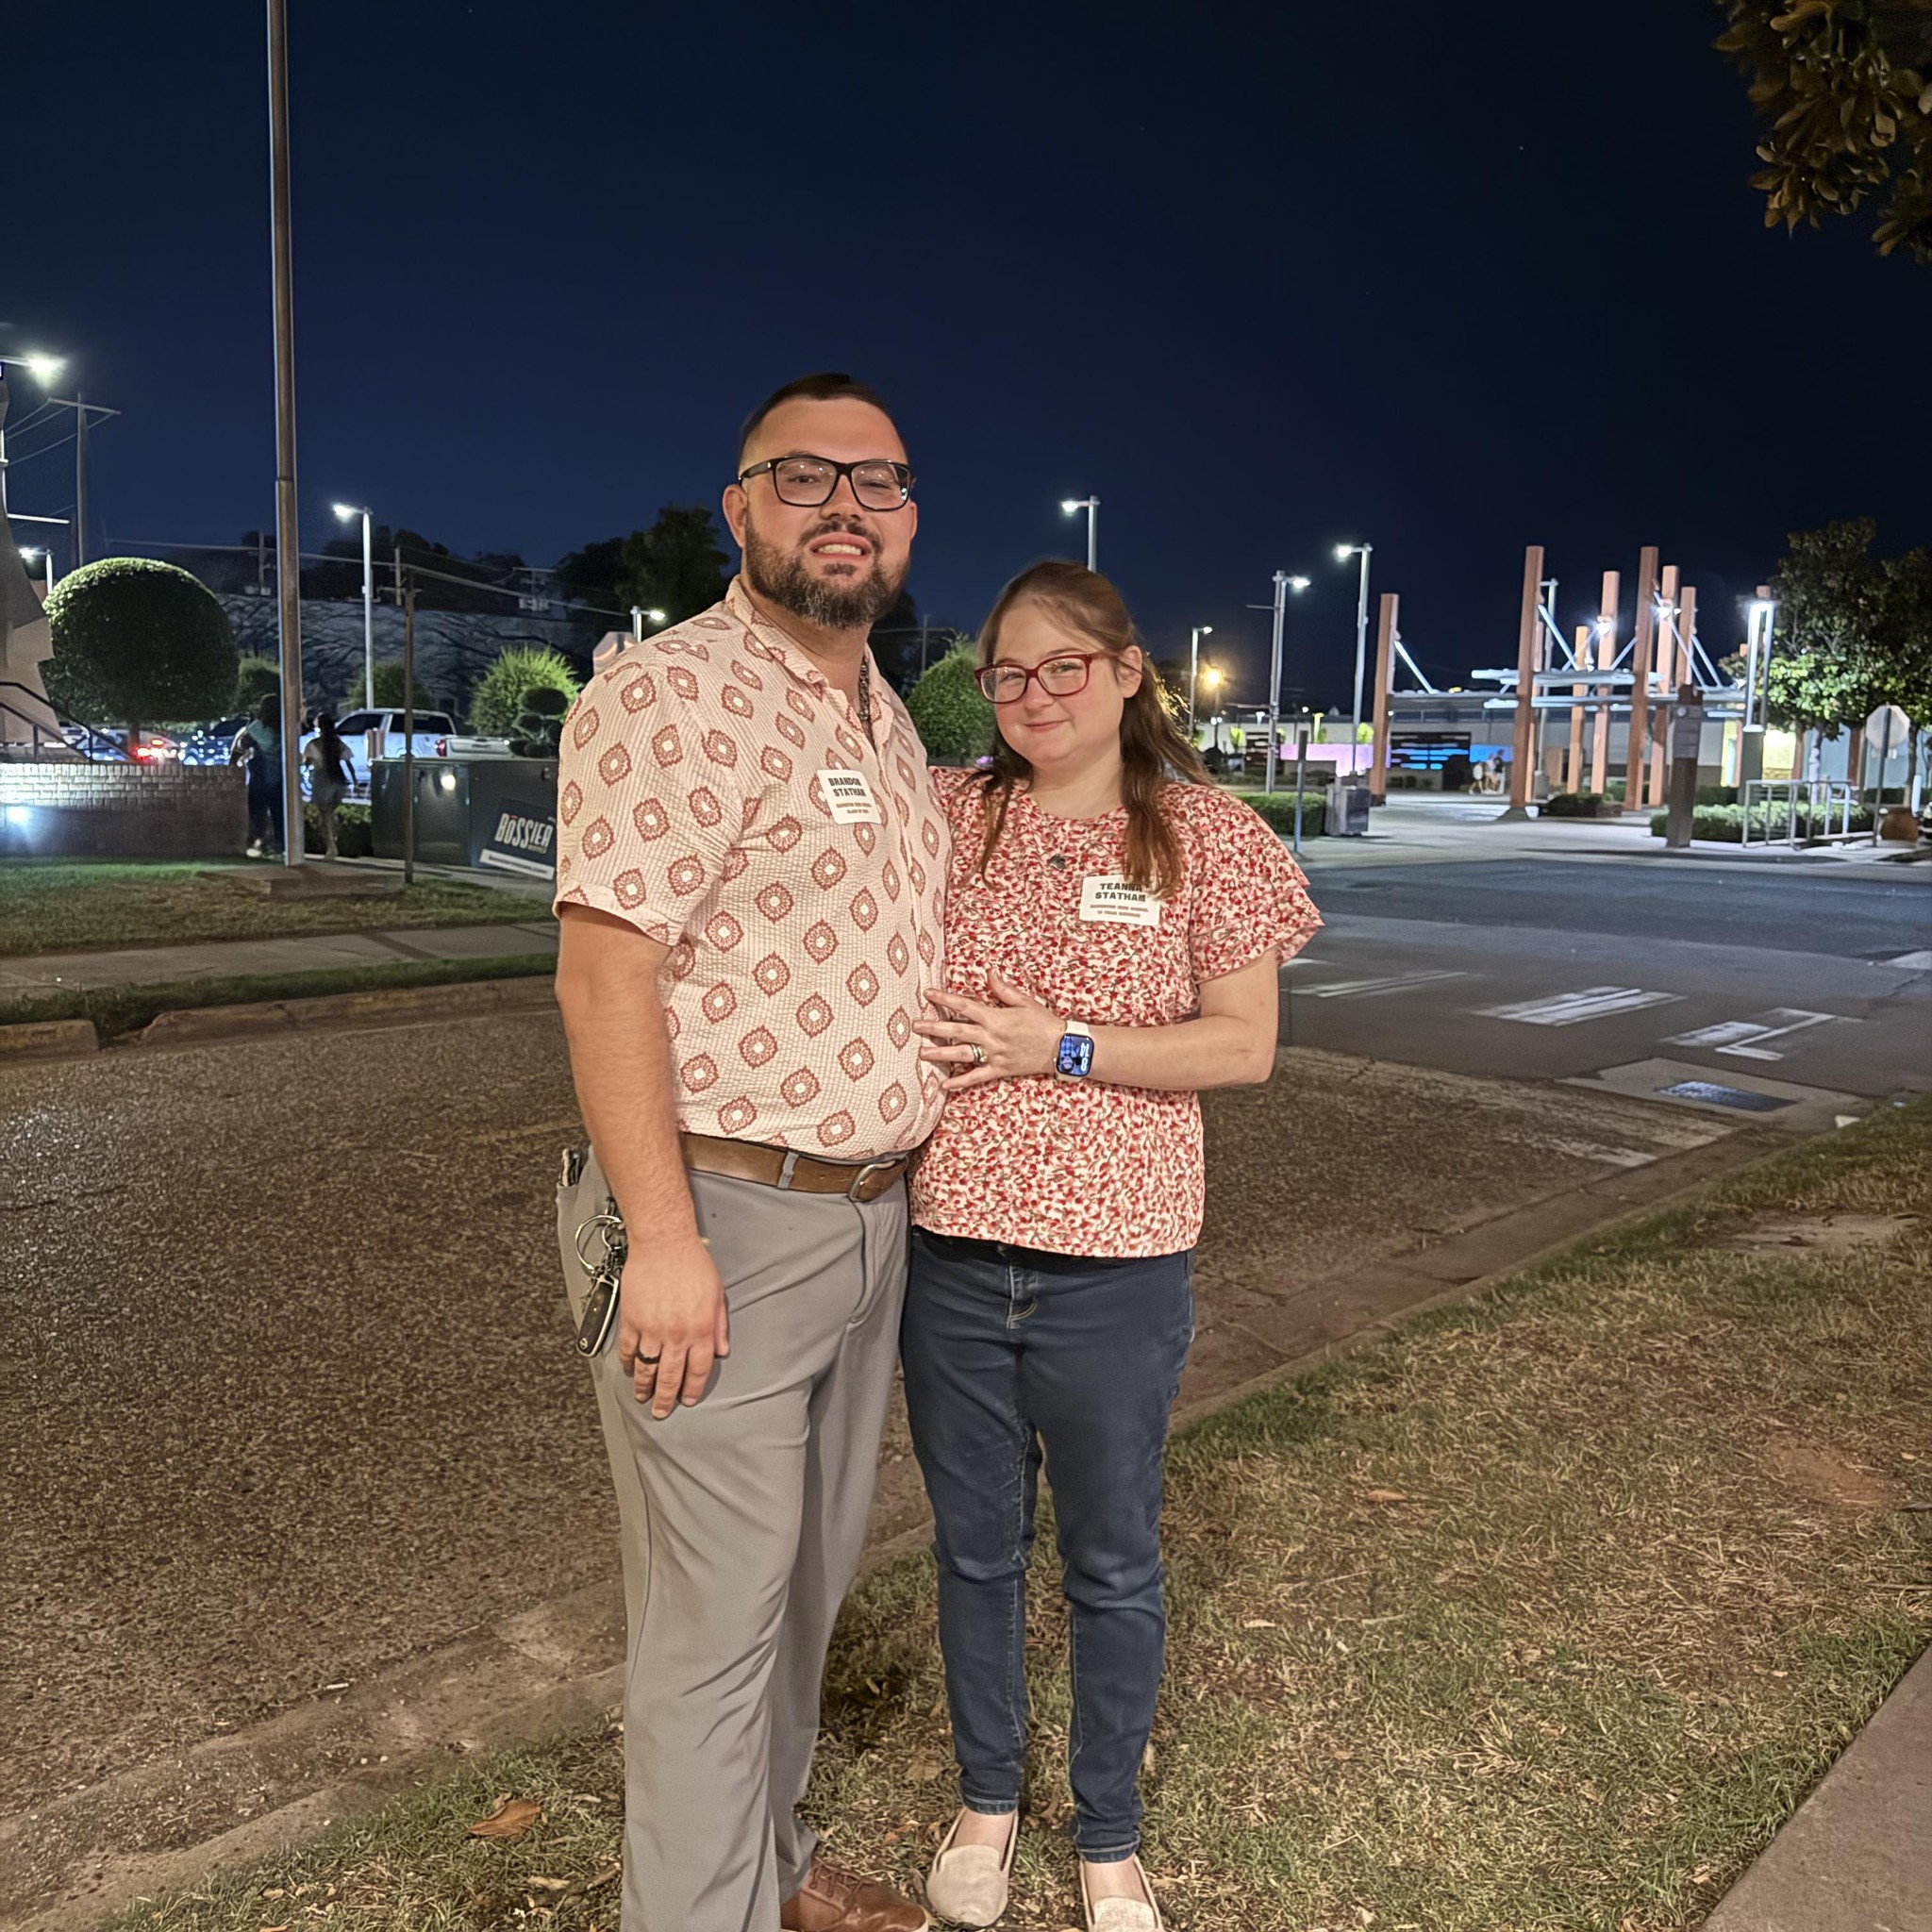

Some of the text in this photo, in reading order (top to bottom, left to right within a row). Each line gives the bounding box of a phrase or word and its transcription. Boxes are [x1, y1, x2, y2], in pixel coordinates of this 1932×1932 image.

[827, 776, 862, 787] BRANDON
[832, 788, 867, 797] STATHAM
[1099, 882, 1143, 892] TEANNA
[1094, 891, 1146, 903] STATHAM
